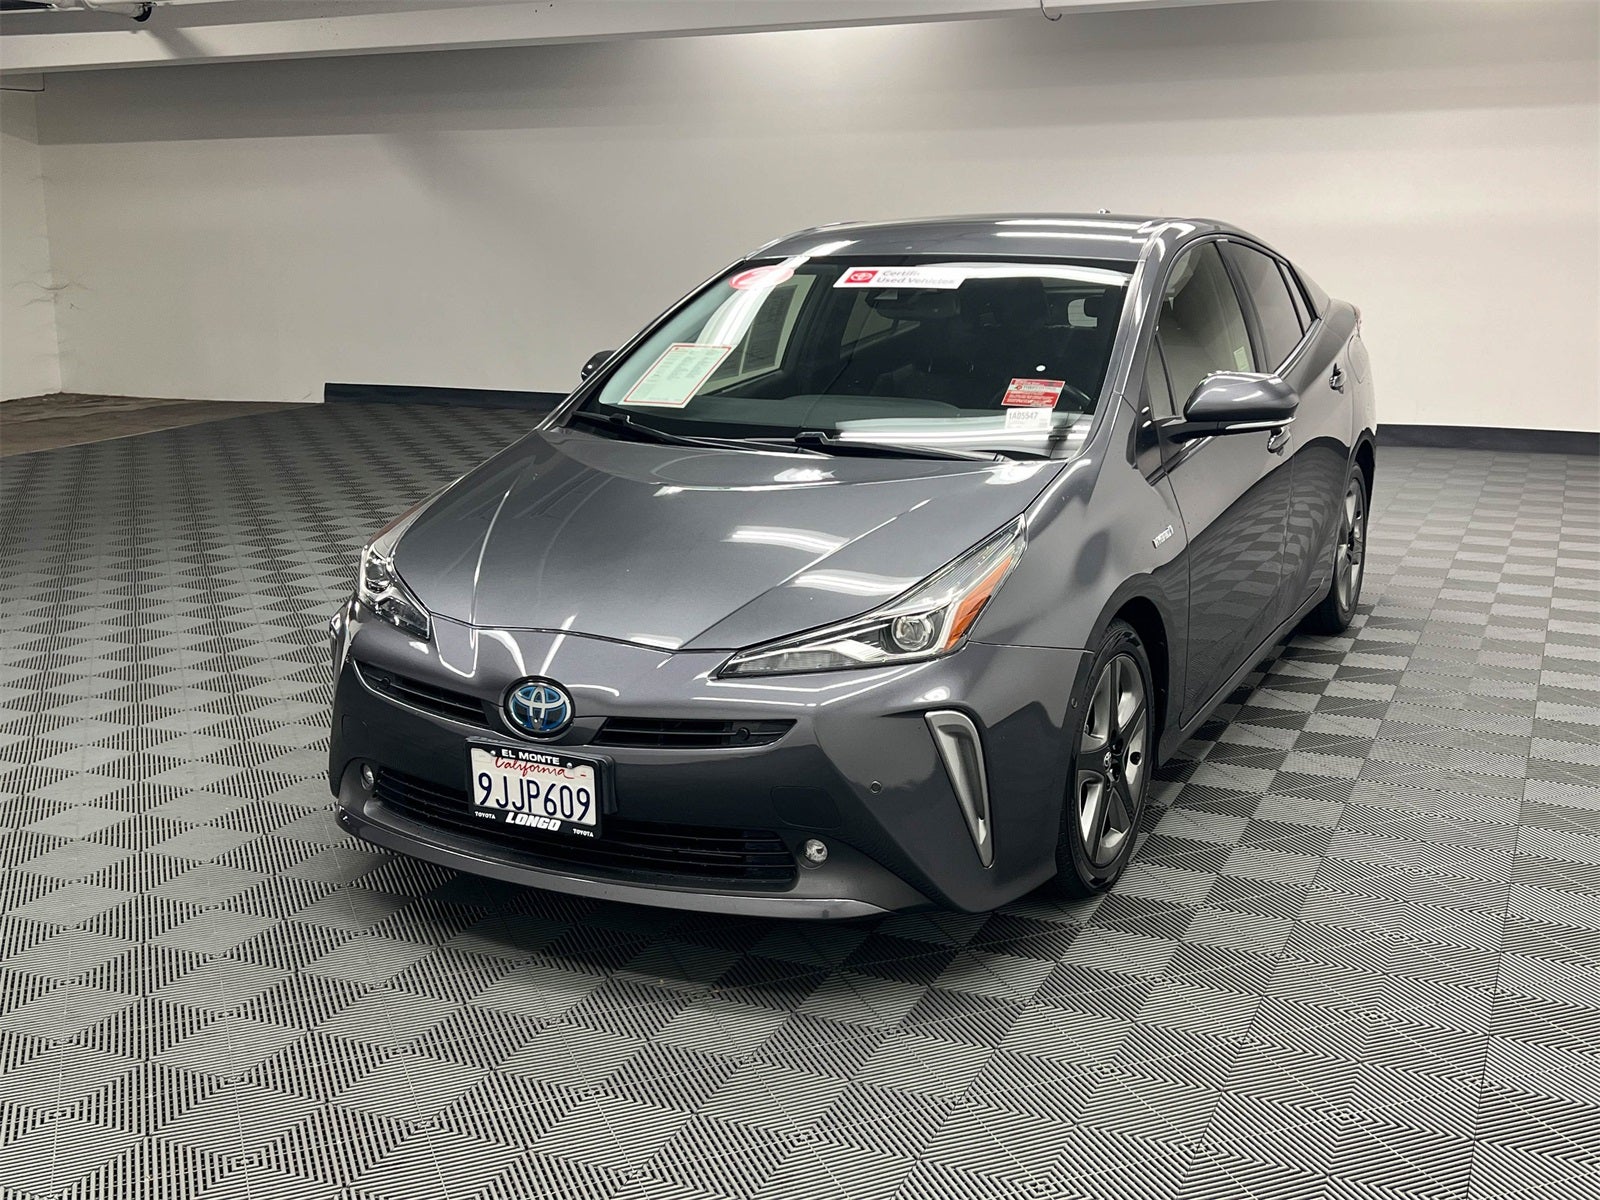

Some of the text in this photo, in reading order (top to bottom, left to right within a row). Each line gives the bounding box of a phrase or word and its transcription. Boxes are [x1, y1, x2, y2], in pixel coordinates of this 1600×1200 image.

[501, 748, 560, 765] EL MONTE
[495, 756, 574, 779] California
[478, 772, 590, 821] 9JJP609
[474, 811, 496, 820] TOYOTA
[505, 811, 562, 832] LONGO
[572, 828, 594, 837] TOYOTA
